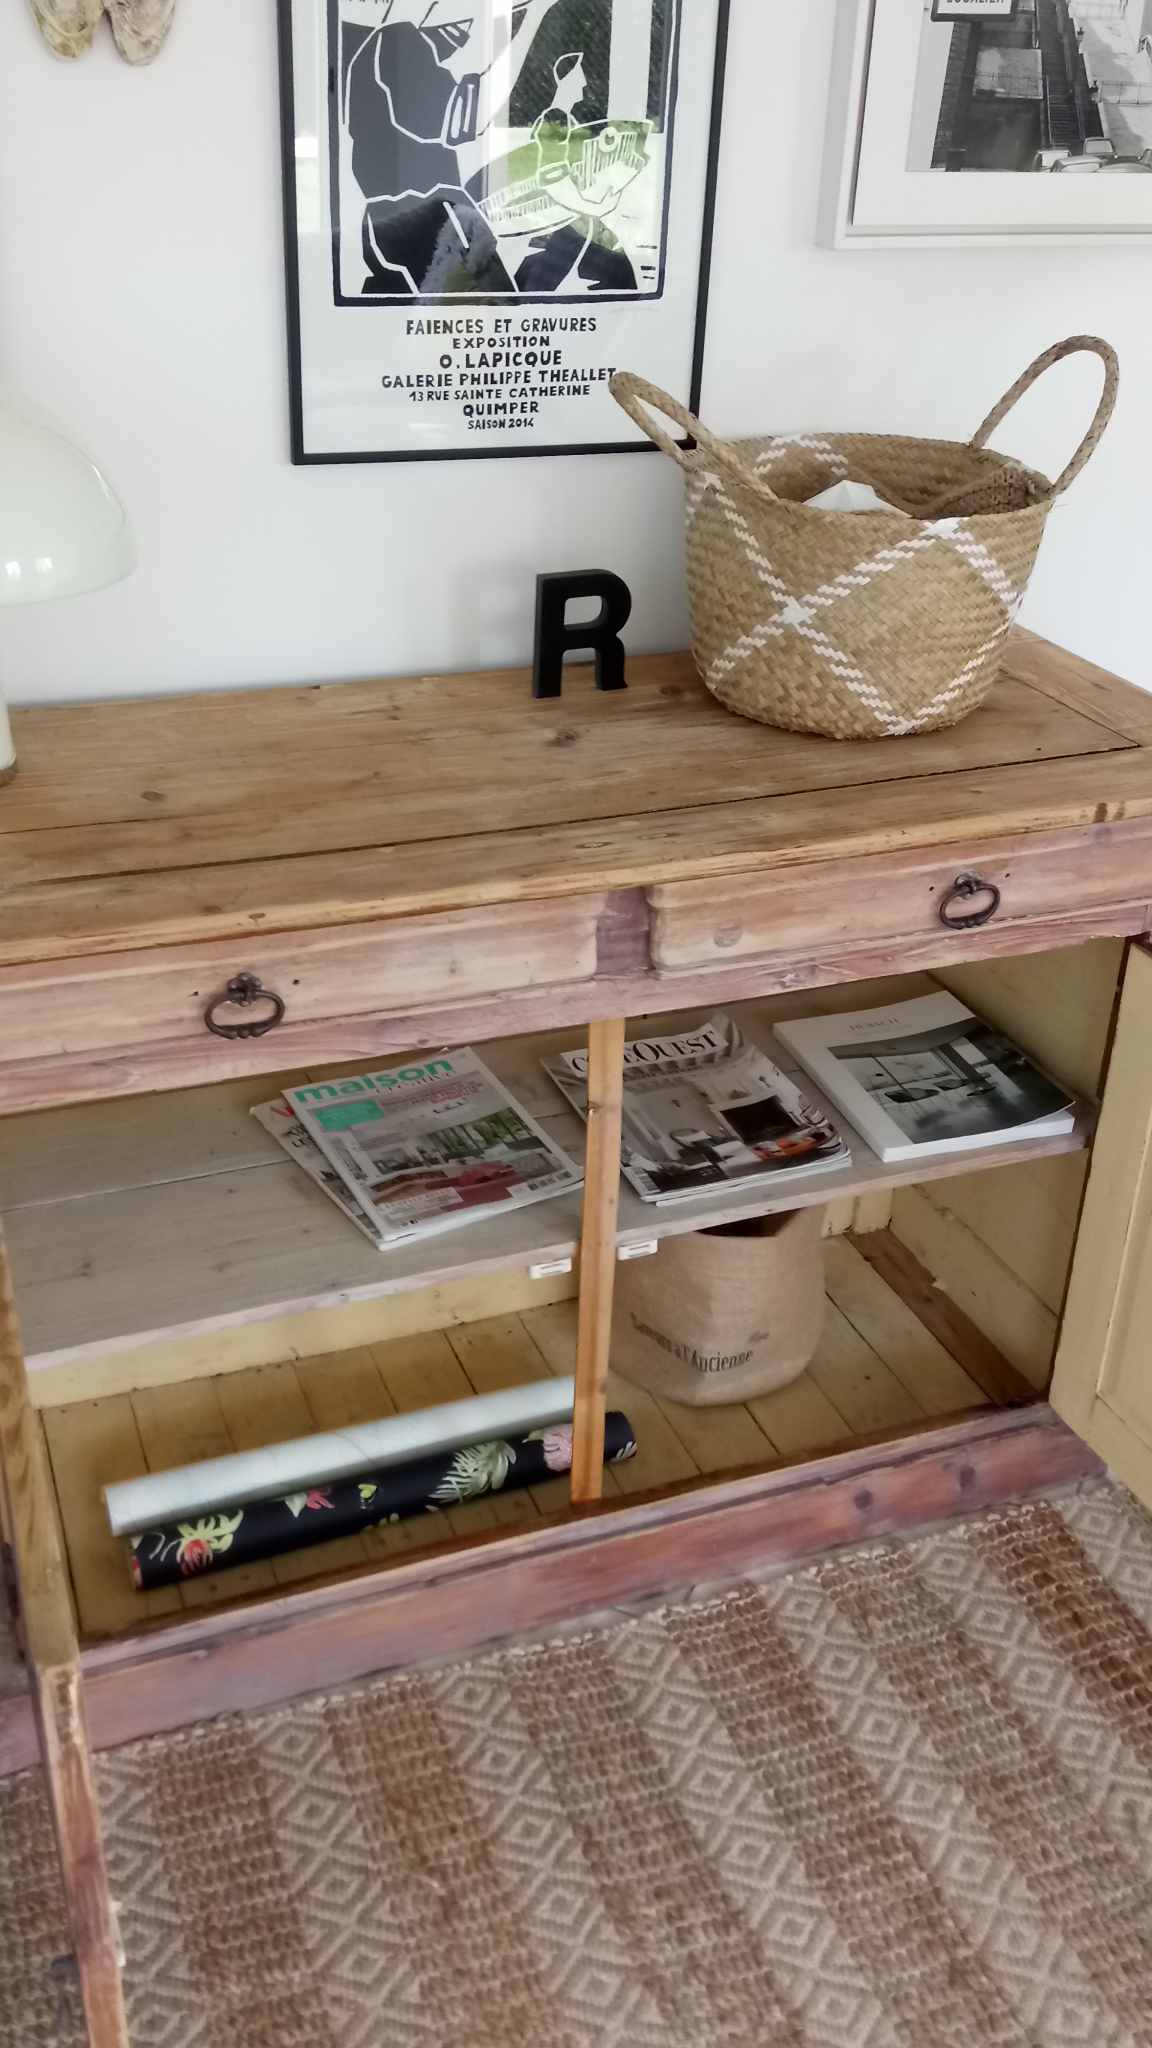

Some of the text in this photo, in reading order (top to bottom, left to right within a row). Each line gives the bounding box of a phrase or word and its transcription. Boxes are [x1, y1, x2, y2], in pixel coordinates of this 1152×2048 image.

[407, 318, 596, 335] FAIENCES ET GRAVURES
[453, 336, 550, 349] EXPOSITION
[382, 368, 616, 388] GALERIE PHILIPPE THEALLET
[409, 383, 590, 401] 13 RUE SAINTE CATHERINE
[463, 401, 539, 418] QUIMPER
[468, 418, 534, 429] SAISON 2014
[532, 569, 632, 699] R
[295, 1060, 454, 1103] maison
